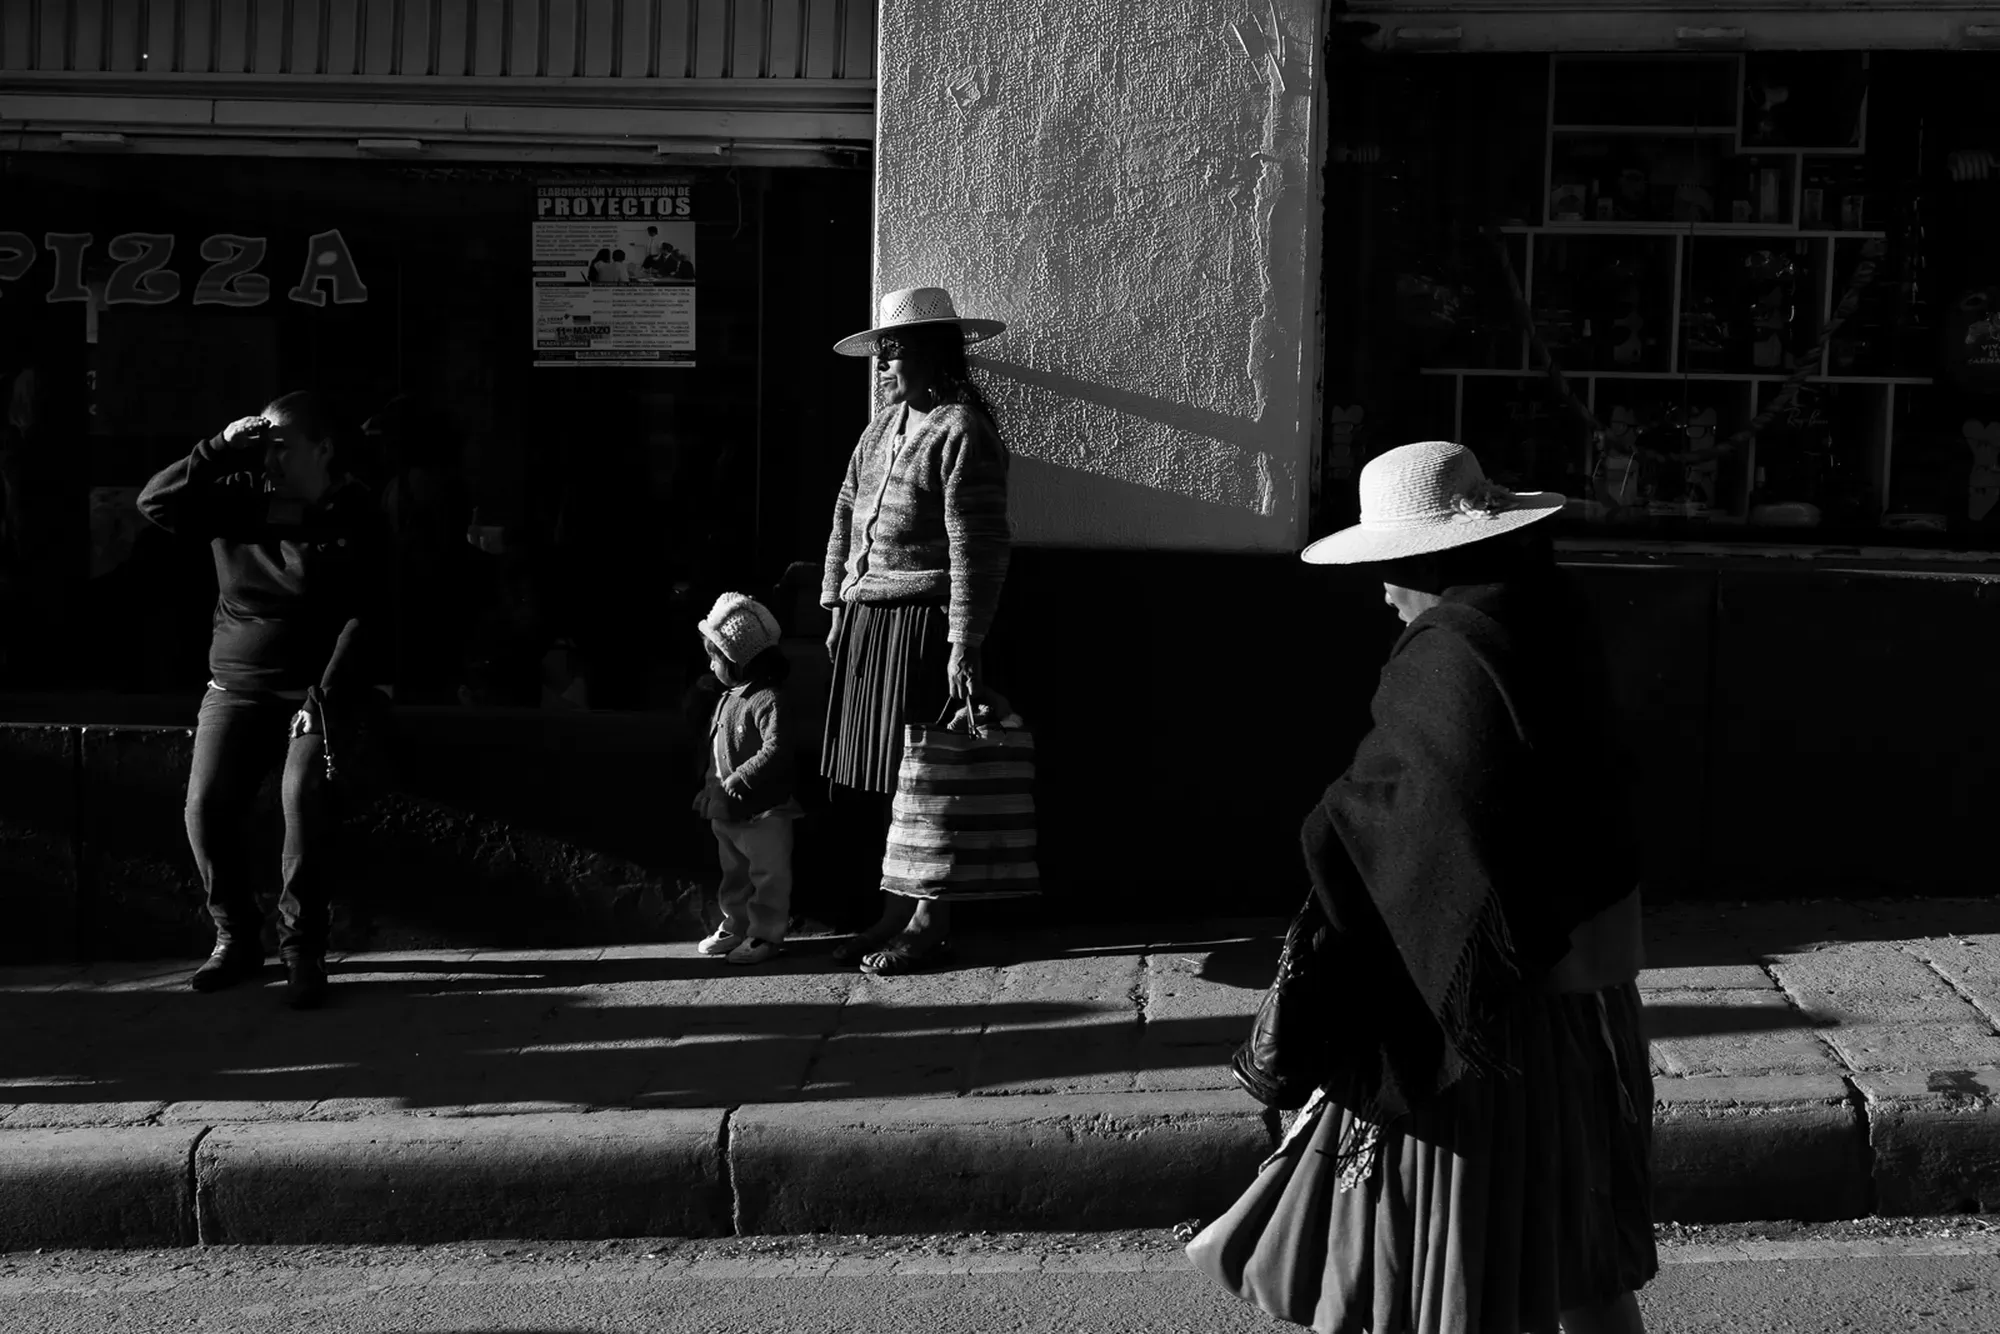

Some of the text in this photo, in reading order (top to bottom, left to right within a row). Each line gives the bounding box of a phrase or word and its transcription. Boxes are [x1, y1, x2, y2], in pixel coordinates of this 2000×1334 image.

[537, 186, 690, 197] ELABORACIÓN Y EVALUACIÓN DE
[537, 197, 691, 216] PROYECTOS
[573, 326, 611, 334] MARZO
